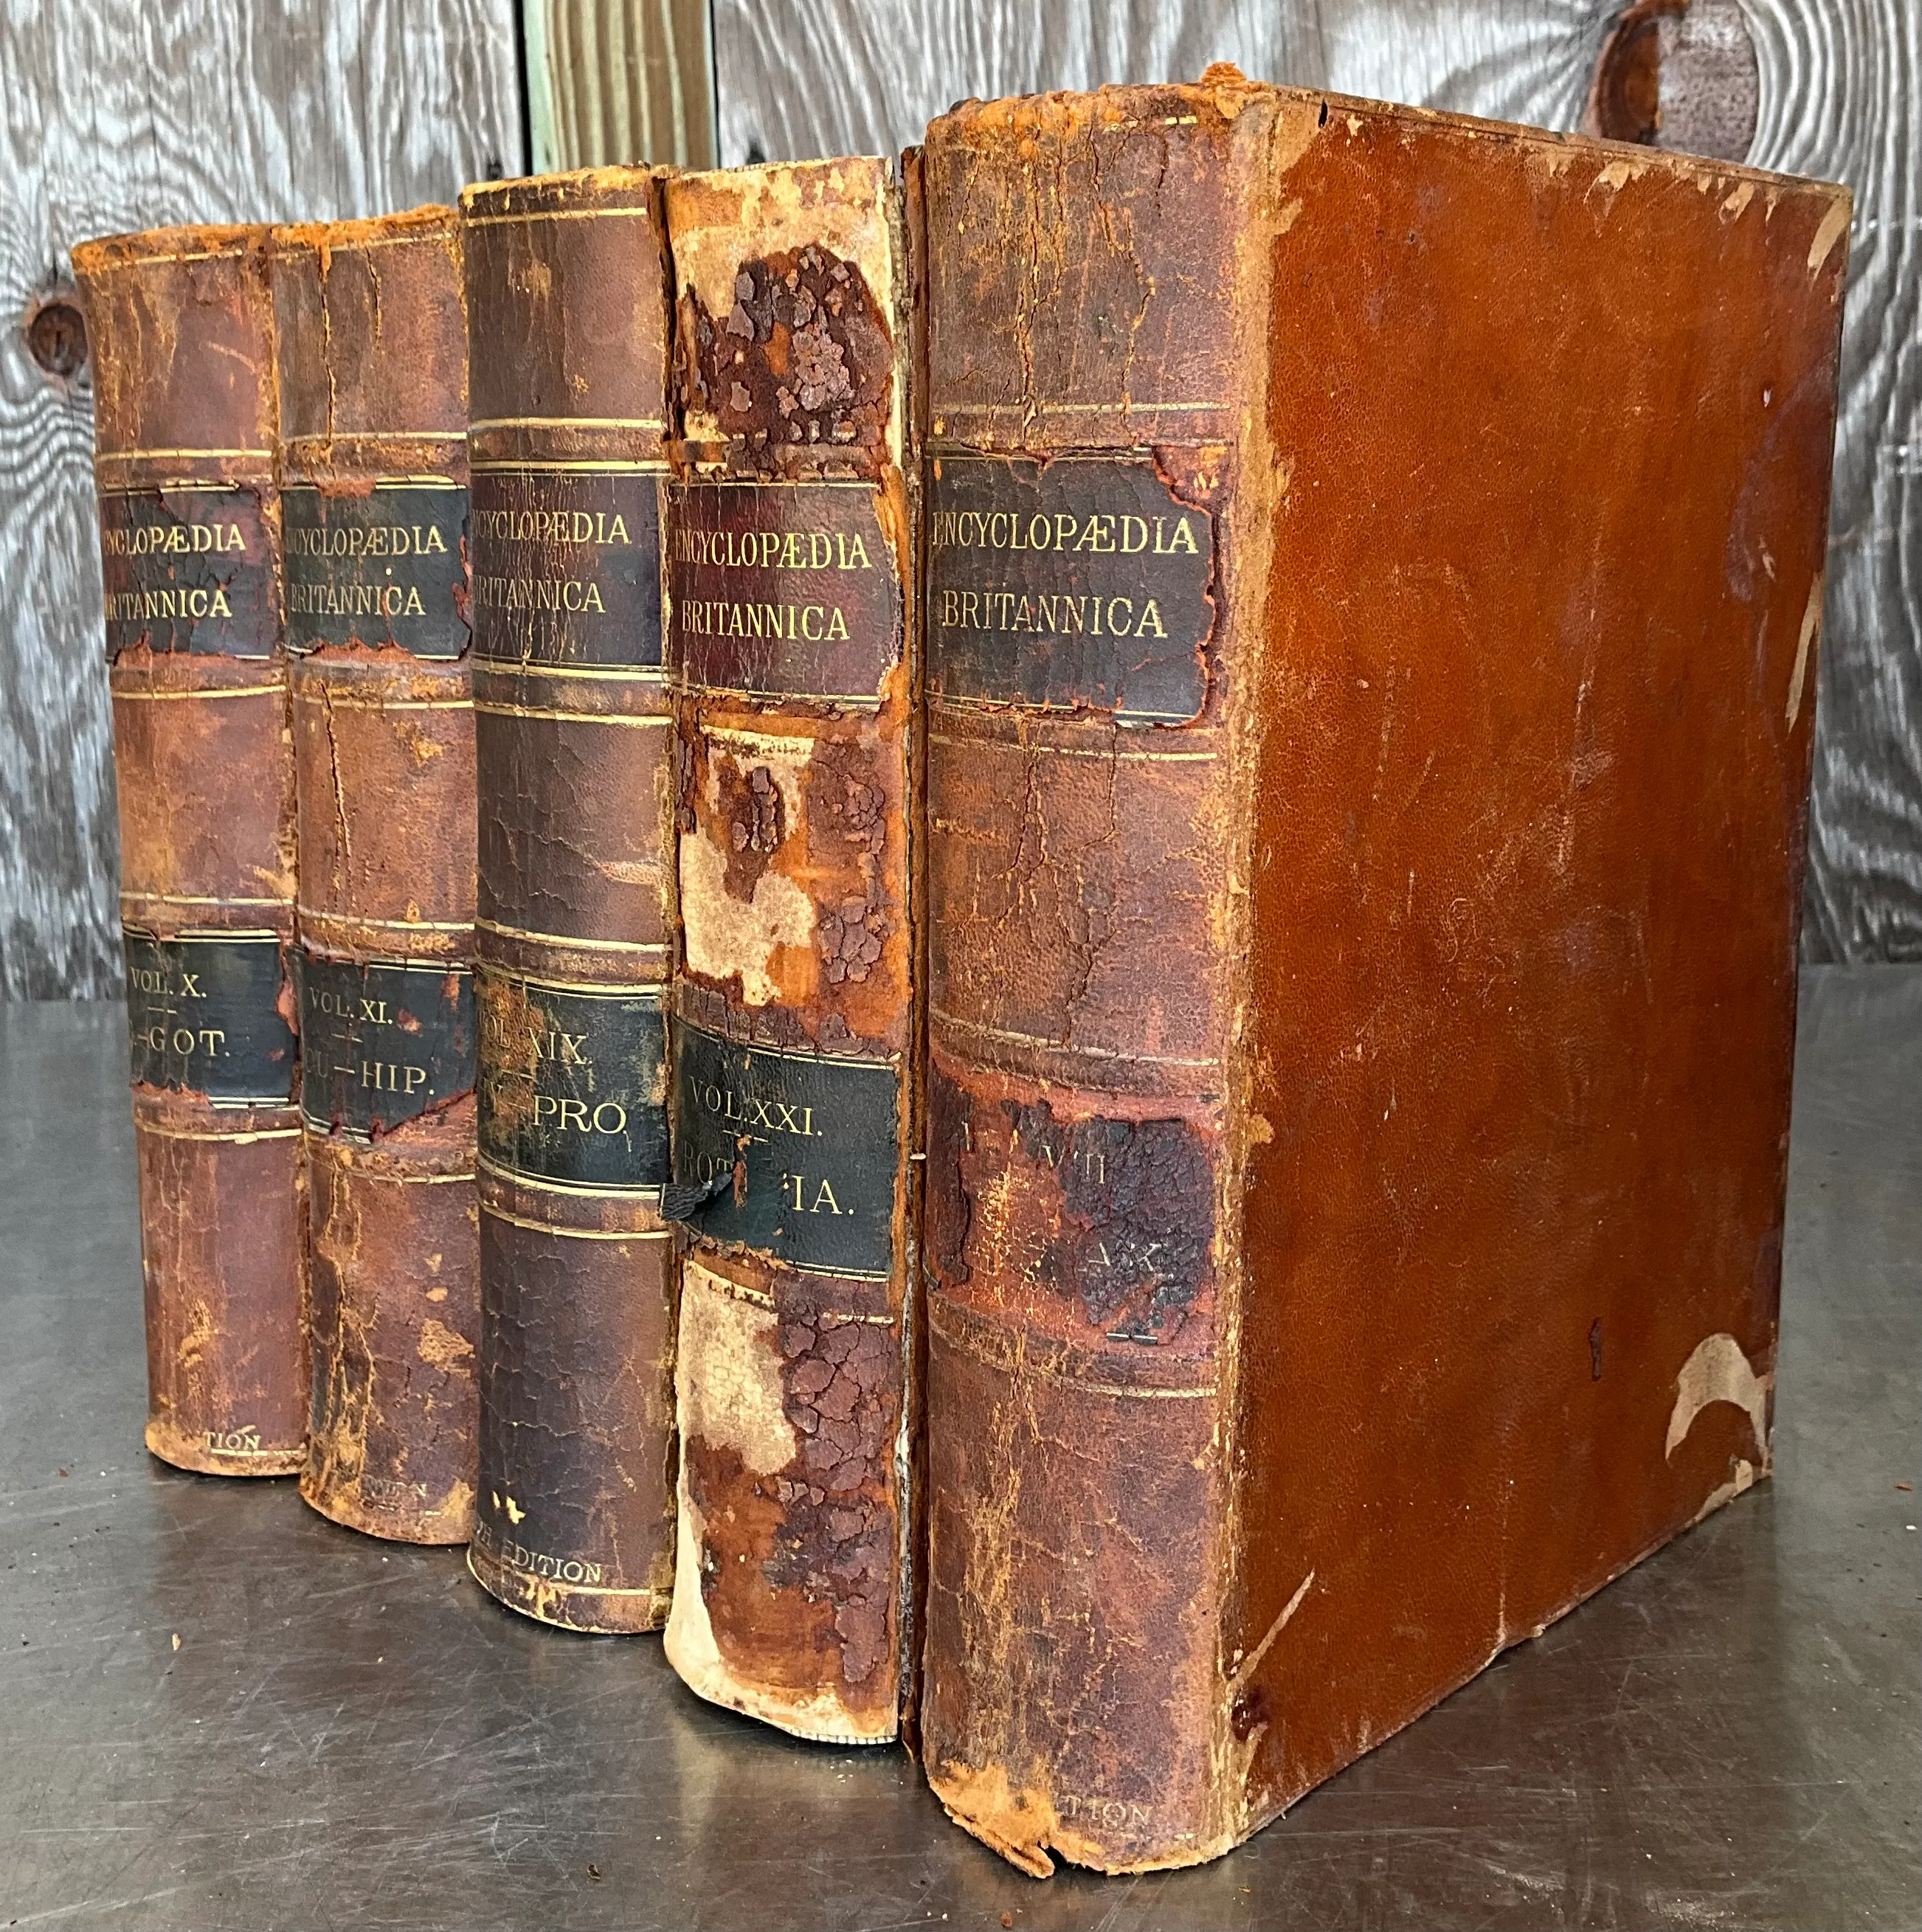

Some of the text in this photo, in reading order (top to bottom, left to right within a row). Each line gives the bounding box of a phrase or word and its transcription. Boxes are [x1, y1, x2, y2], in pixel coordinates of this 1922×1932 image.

[291, 584, 426, 617] BRITANNICA
[942, 589, 1168, 638] BRITANNICA
[682, 600, 851, 641] BRITANNICA
[202, 1431, 261, 1450] TION
